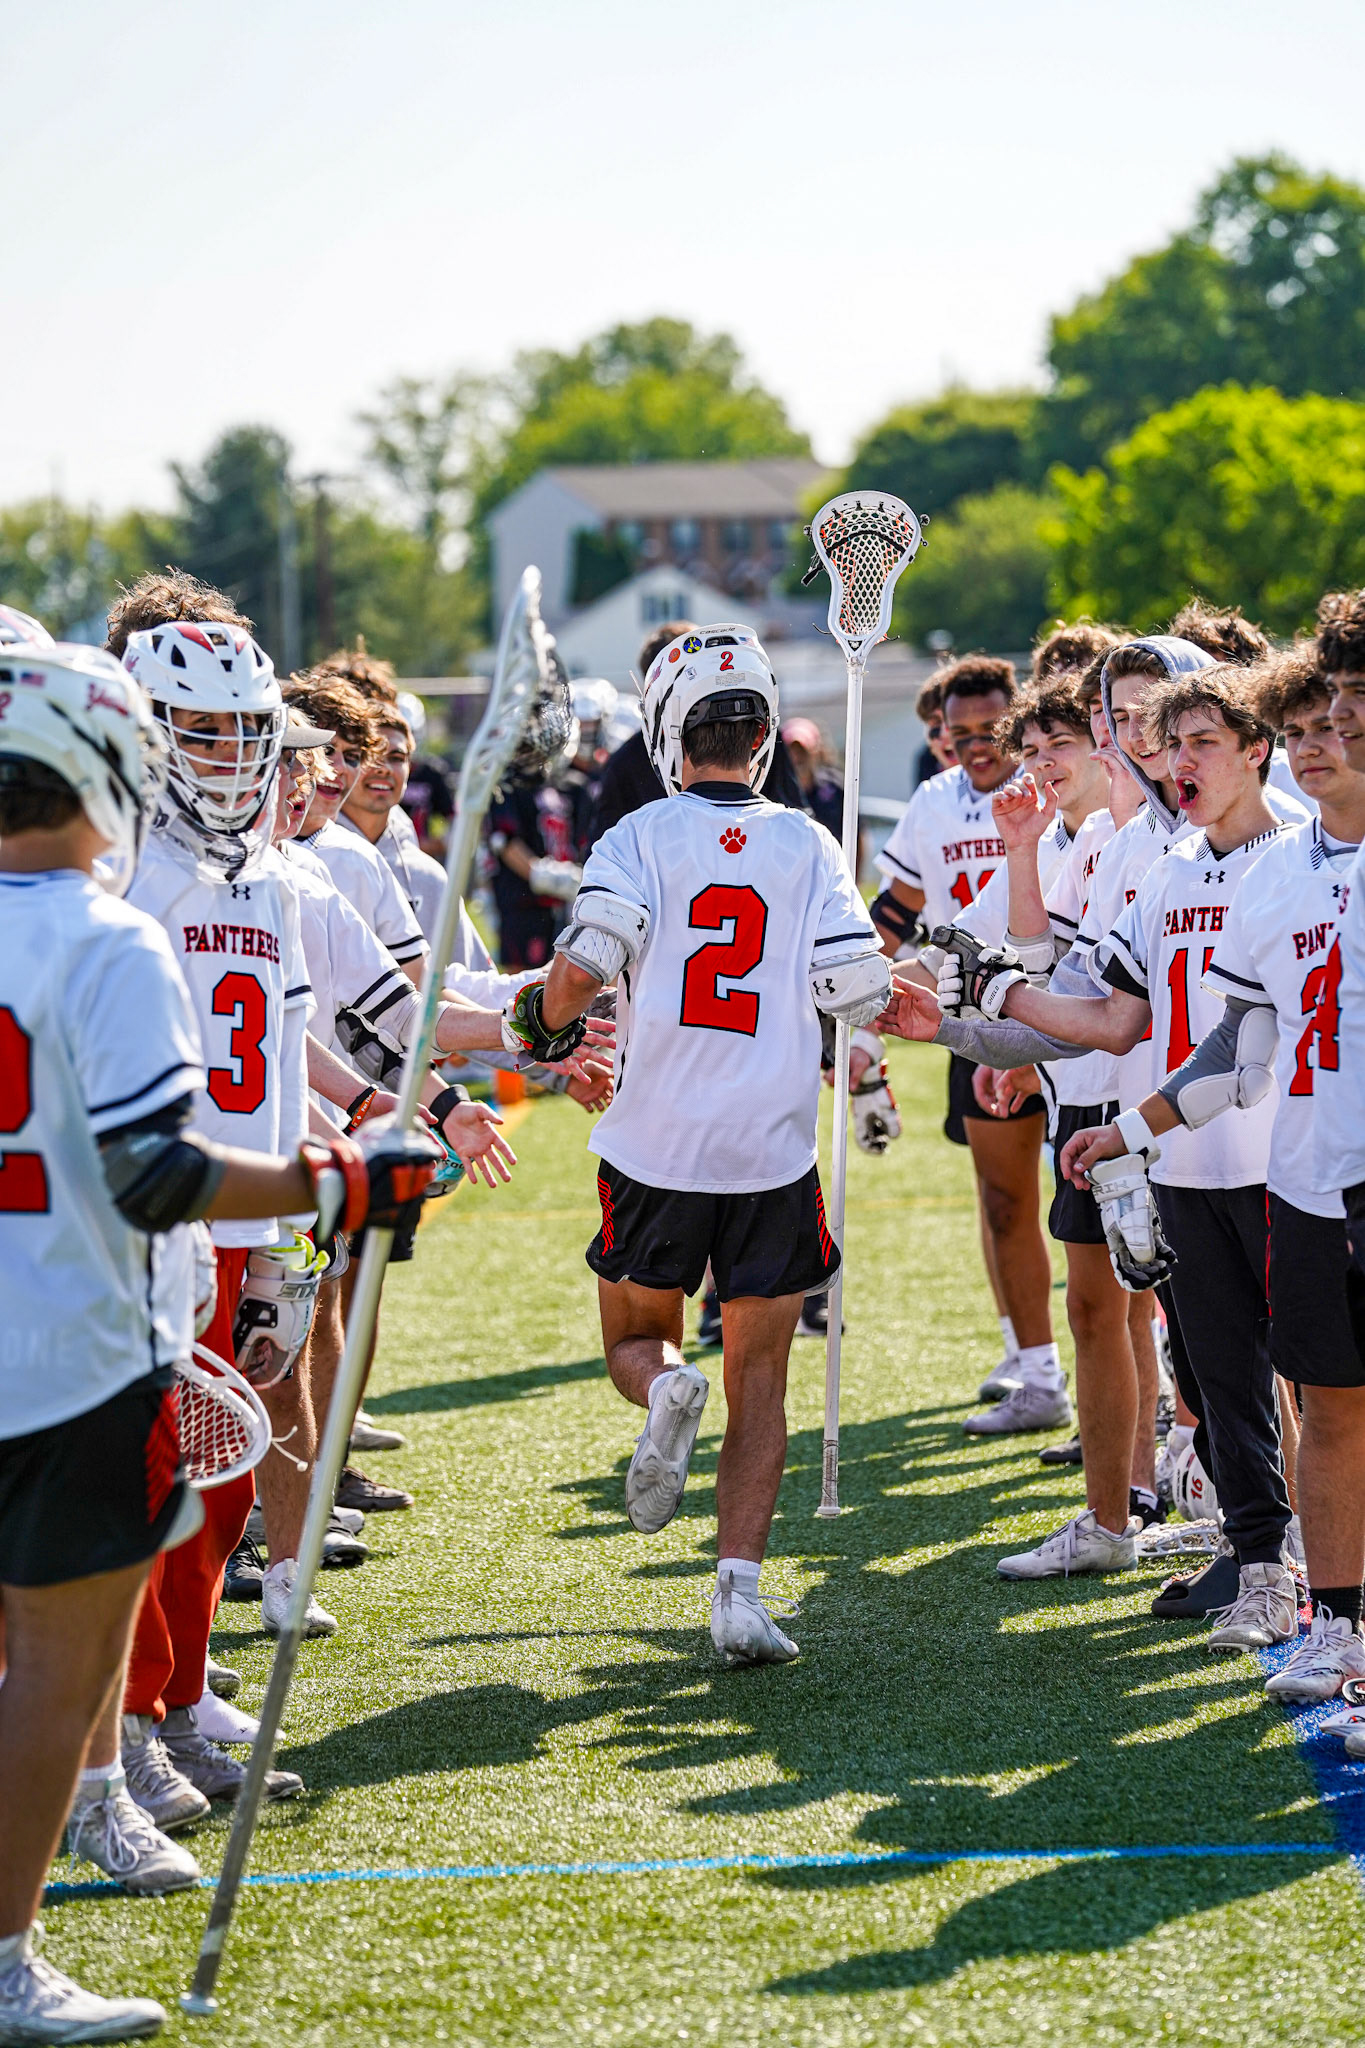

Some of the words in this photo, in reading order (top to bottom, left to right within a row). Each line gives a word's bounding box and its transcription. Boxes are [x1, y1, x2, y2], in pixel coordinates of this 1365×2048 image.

[720, 651, 735, 672] 2
[1162, 905, 1230, 938] PANTH
[183, 923, 280, 964] PANTHERS
[679, 882, 768, 1038] 2
[207, 971, 268, 1115] 3
[1190, 1476, 1204, 1500] 16
